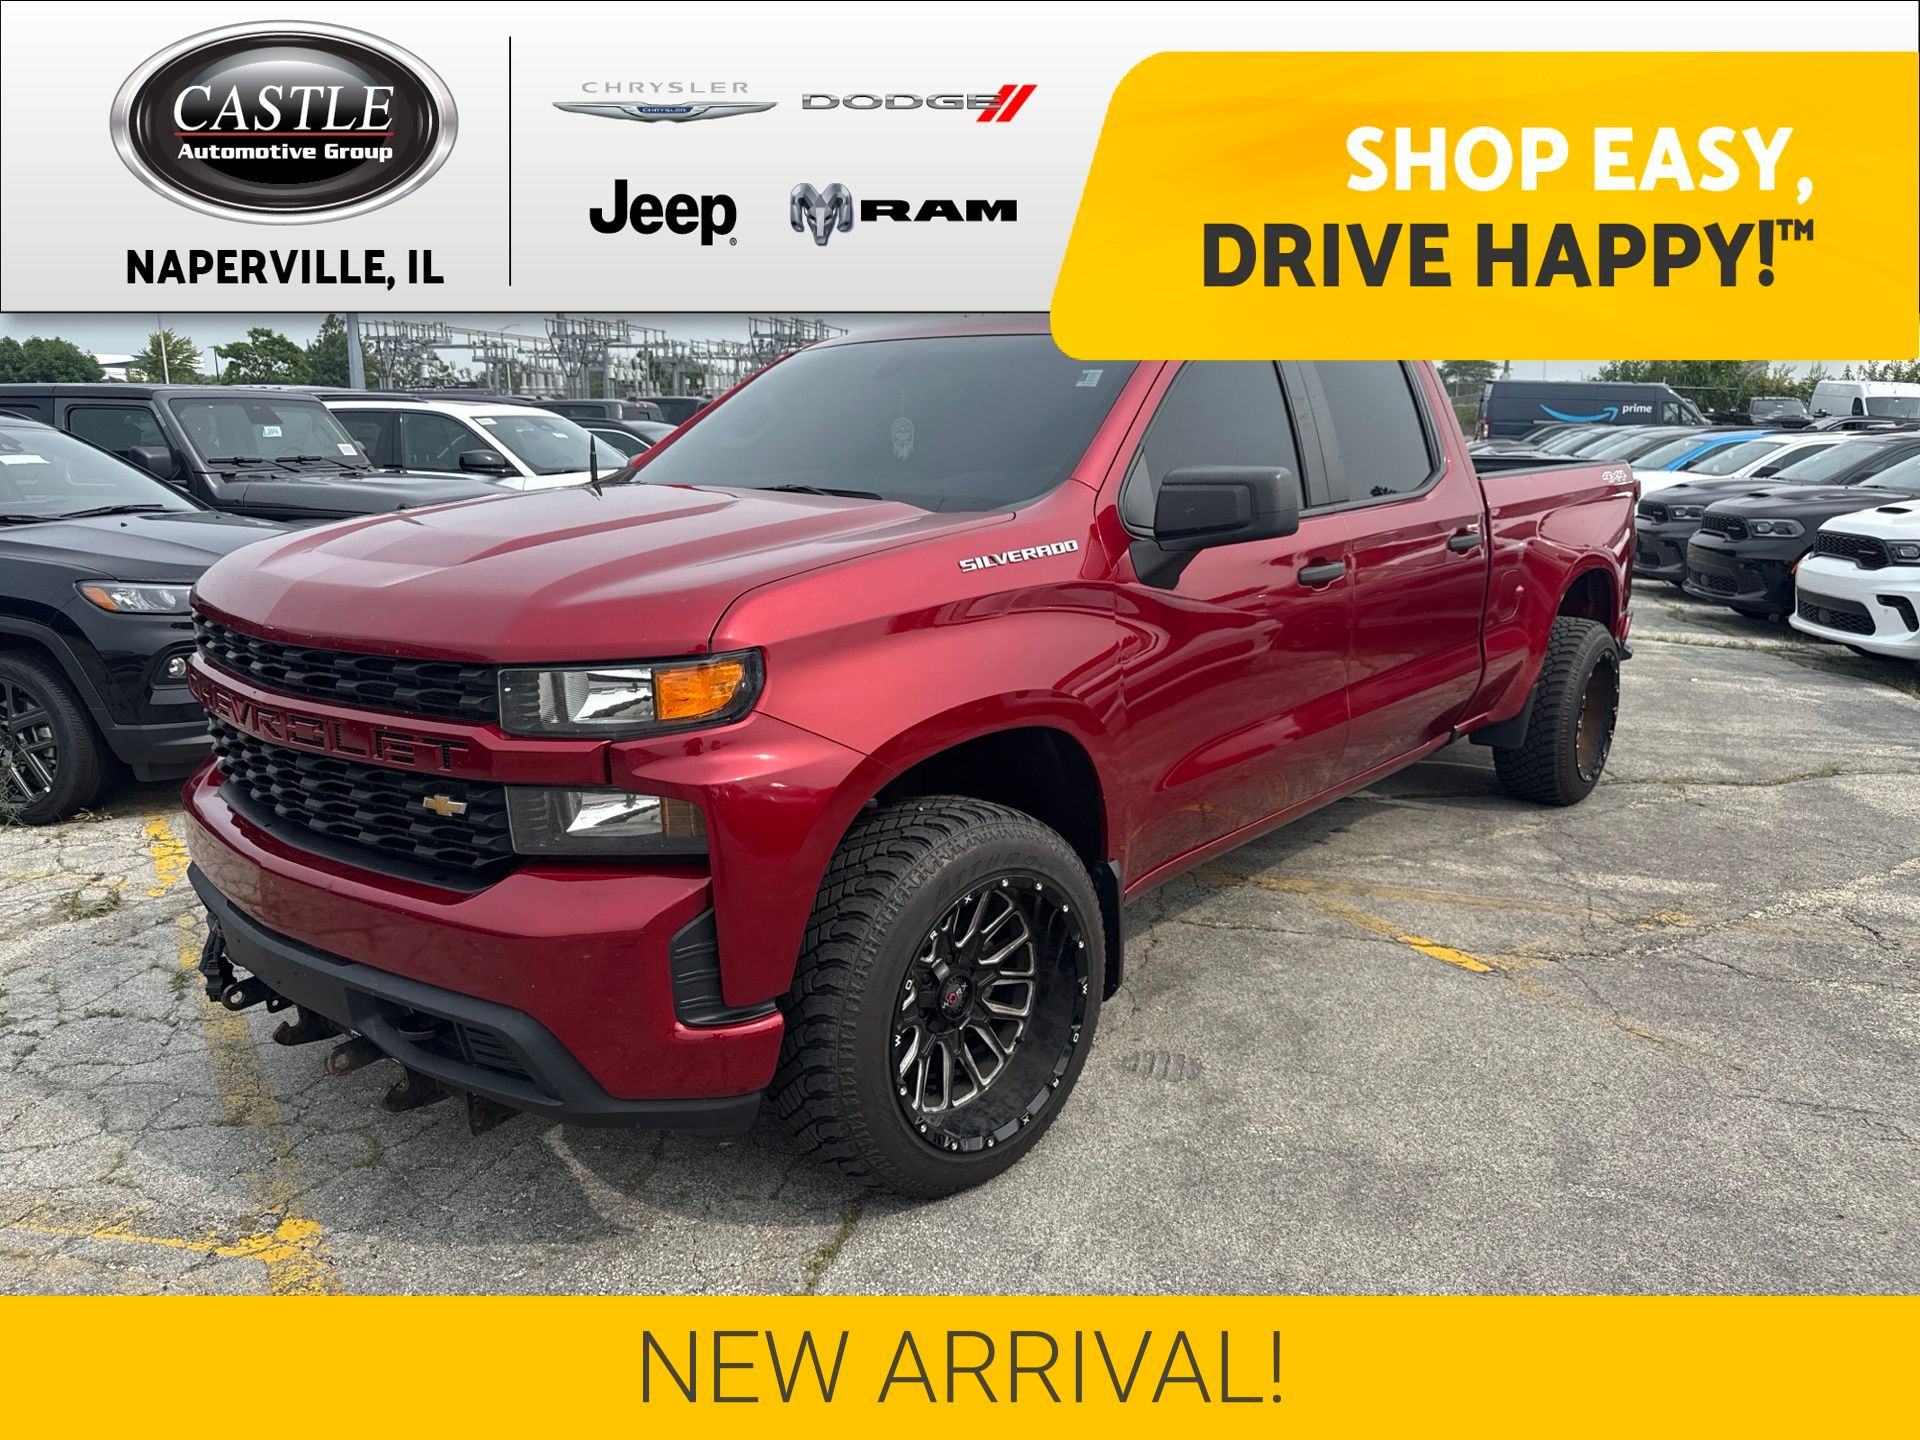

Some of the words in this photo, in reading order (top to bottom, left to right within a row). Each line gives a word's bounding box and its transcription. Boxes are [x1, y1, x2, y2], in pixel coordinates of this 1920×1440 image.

[1622, 403, 1653, 415] prime
[959, 539, 1079, 572] SILVERADO
[189, 672, 469, 772] CHEVROLET
